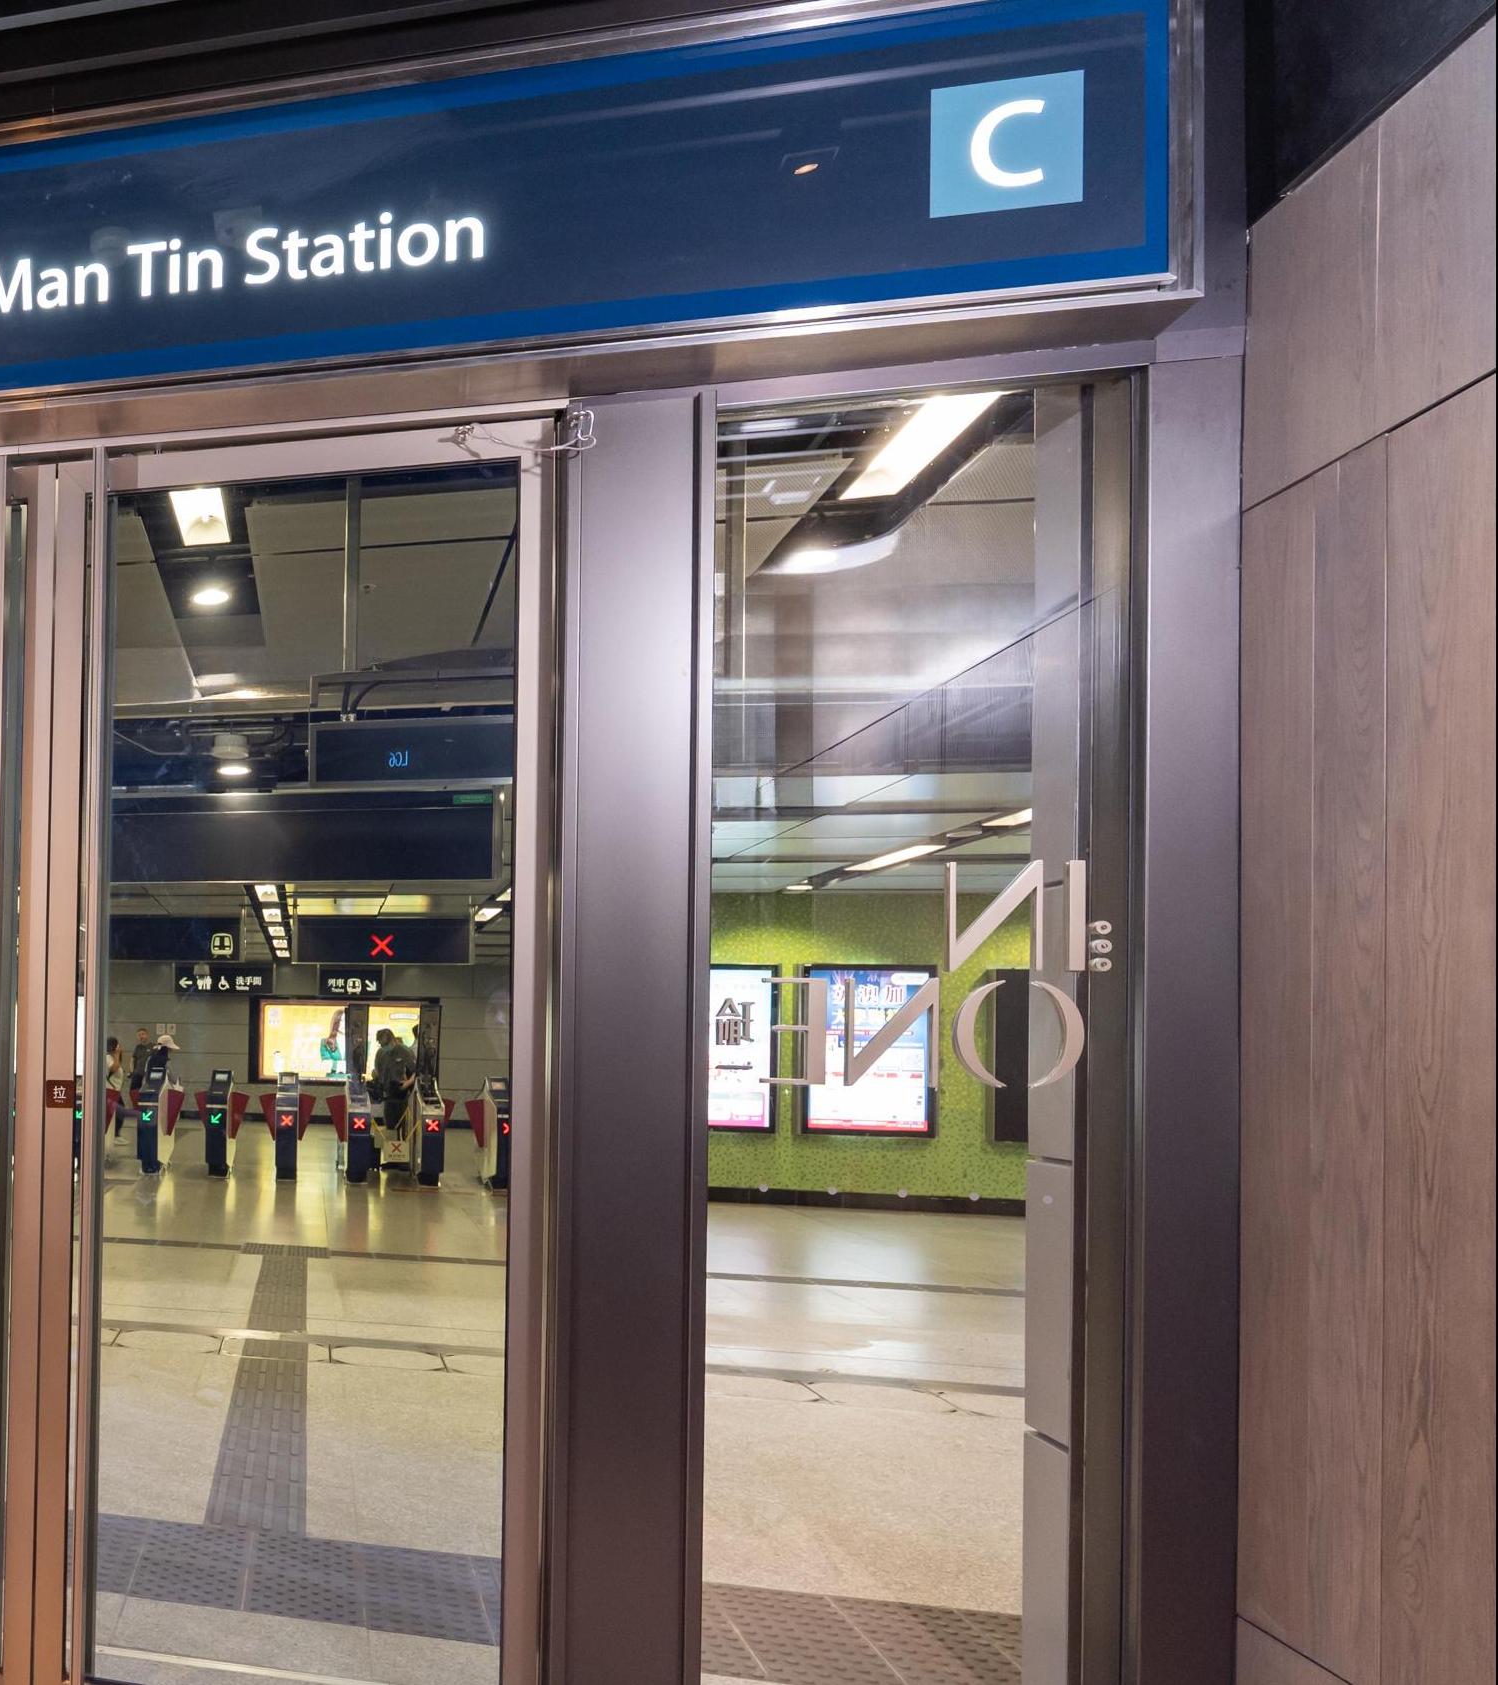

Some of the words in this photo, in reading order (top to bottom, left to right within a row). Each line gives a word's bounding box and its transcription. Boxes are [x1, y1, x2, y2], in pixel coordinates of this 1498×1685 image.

[970, 98, 1046, 188] C
[127, 238, 223, 298] Tin
[244, 211, 485, 285] Station
[327, 978, 345, 988] 列車
[53, 1085, 67, 1099] 拉
